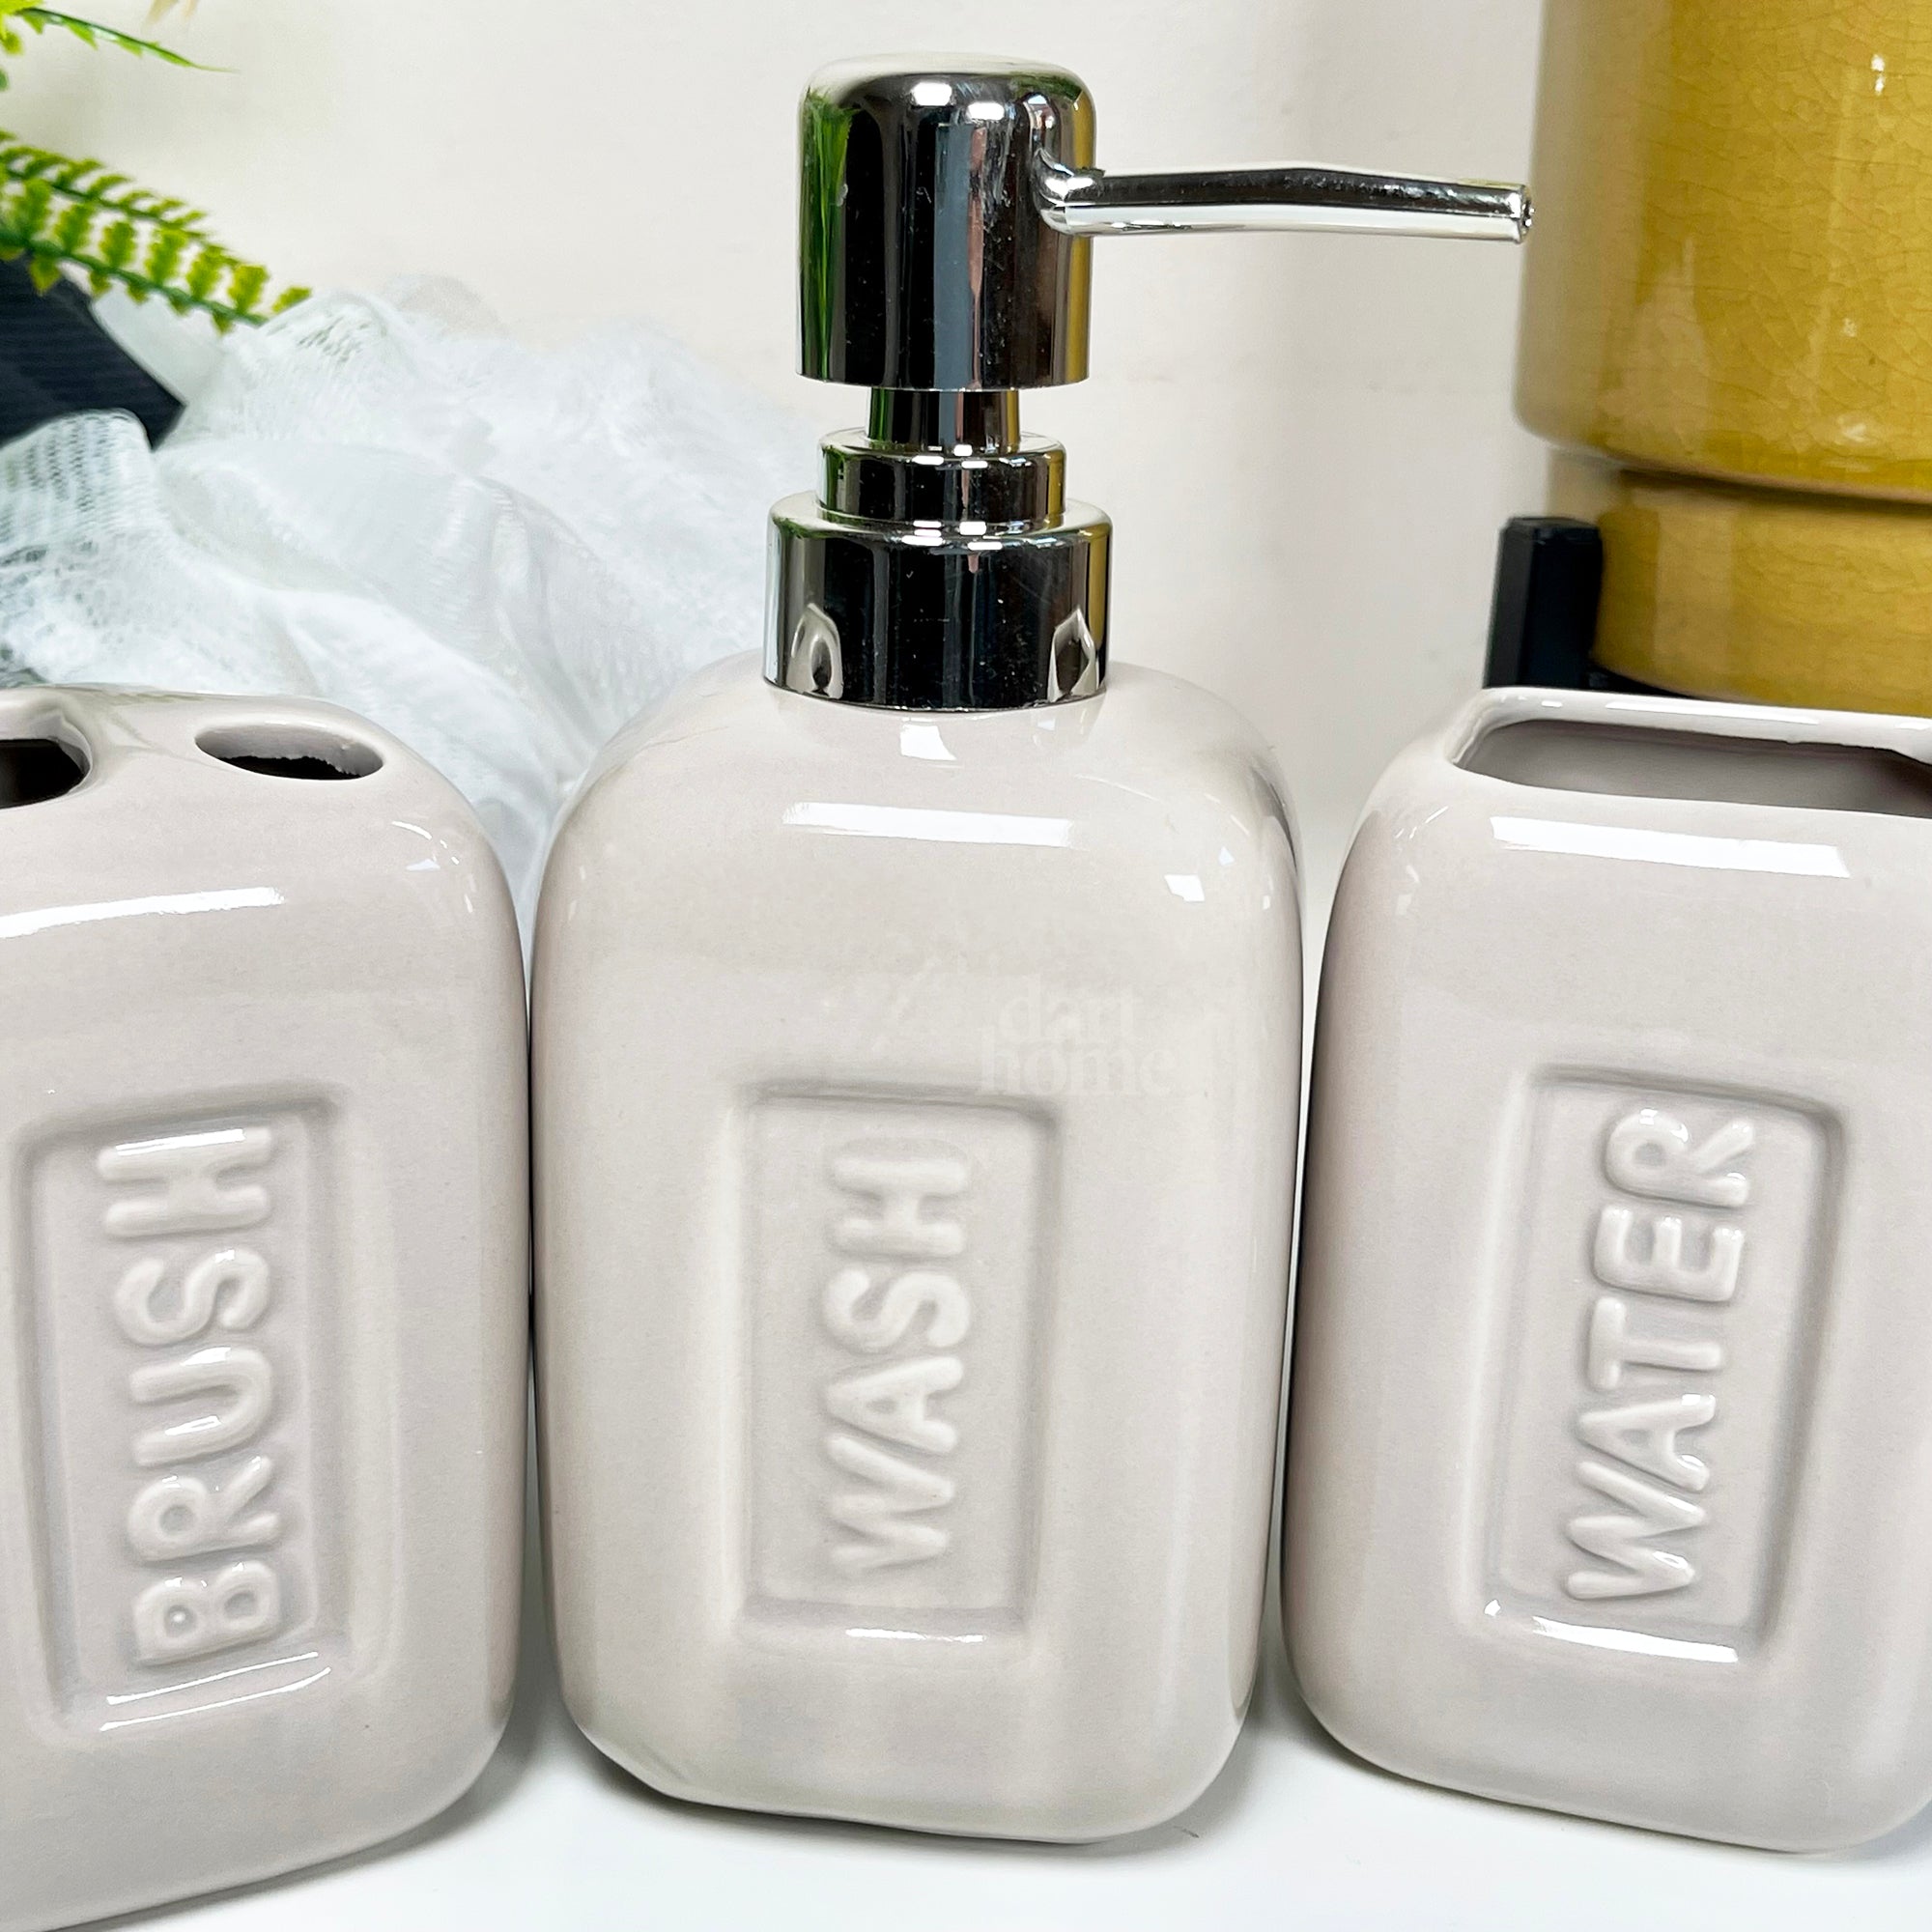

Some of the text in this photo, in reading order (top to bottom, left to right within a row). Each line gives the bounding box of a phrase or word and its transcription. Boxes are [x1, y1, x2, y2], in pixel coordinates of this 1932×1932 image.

[96, 1126, 282, 1667] BRUSH
[821, 1145, 972, 1577] WASH
[1563, 1106, 1755, 1601] WATER
